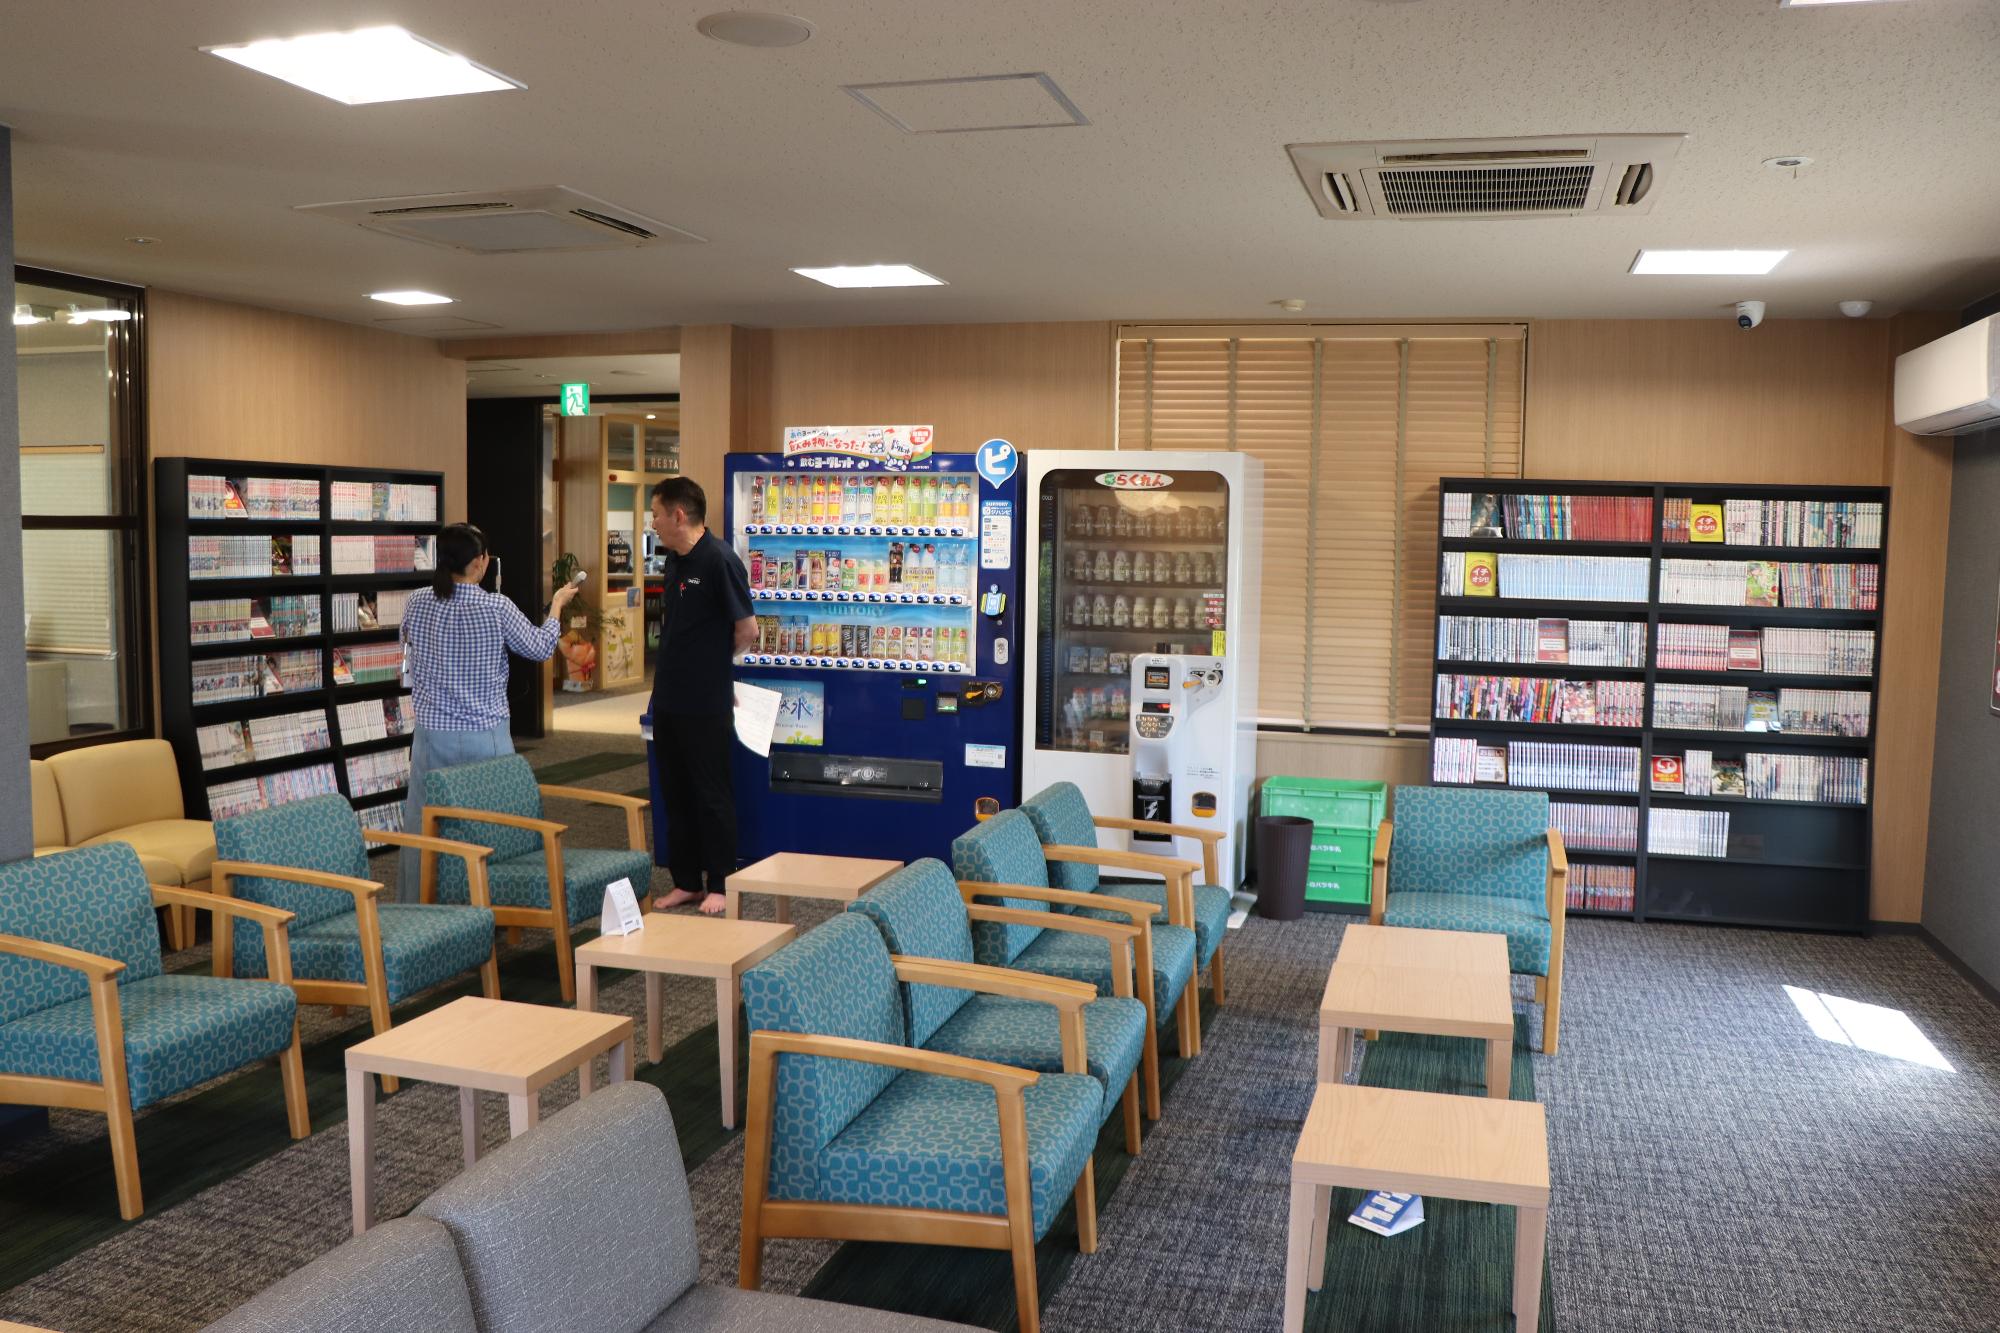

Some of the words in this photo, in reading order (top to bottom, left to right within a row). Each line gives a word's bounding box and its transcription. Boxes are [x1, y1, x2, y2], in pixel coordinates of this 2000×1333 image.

[985, 444, 1011, 475] ピ
[1116, 472, 1164, 486] らくれん
[1473, 568, 1489, 577] イチ
